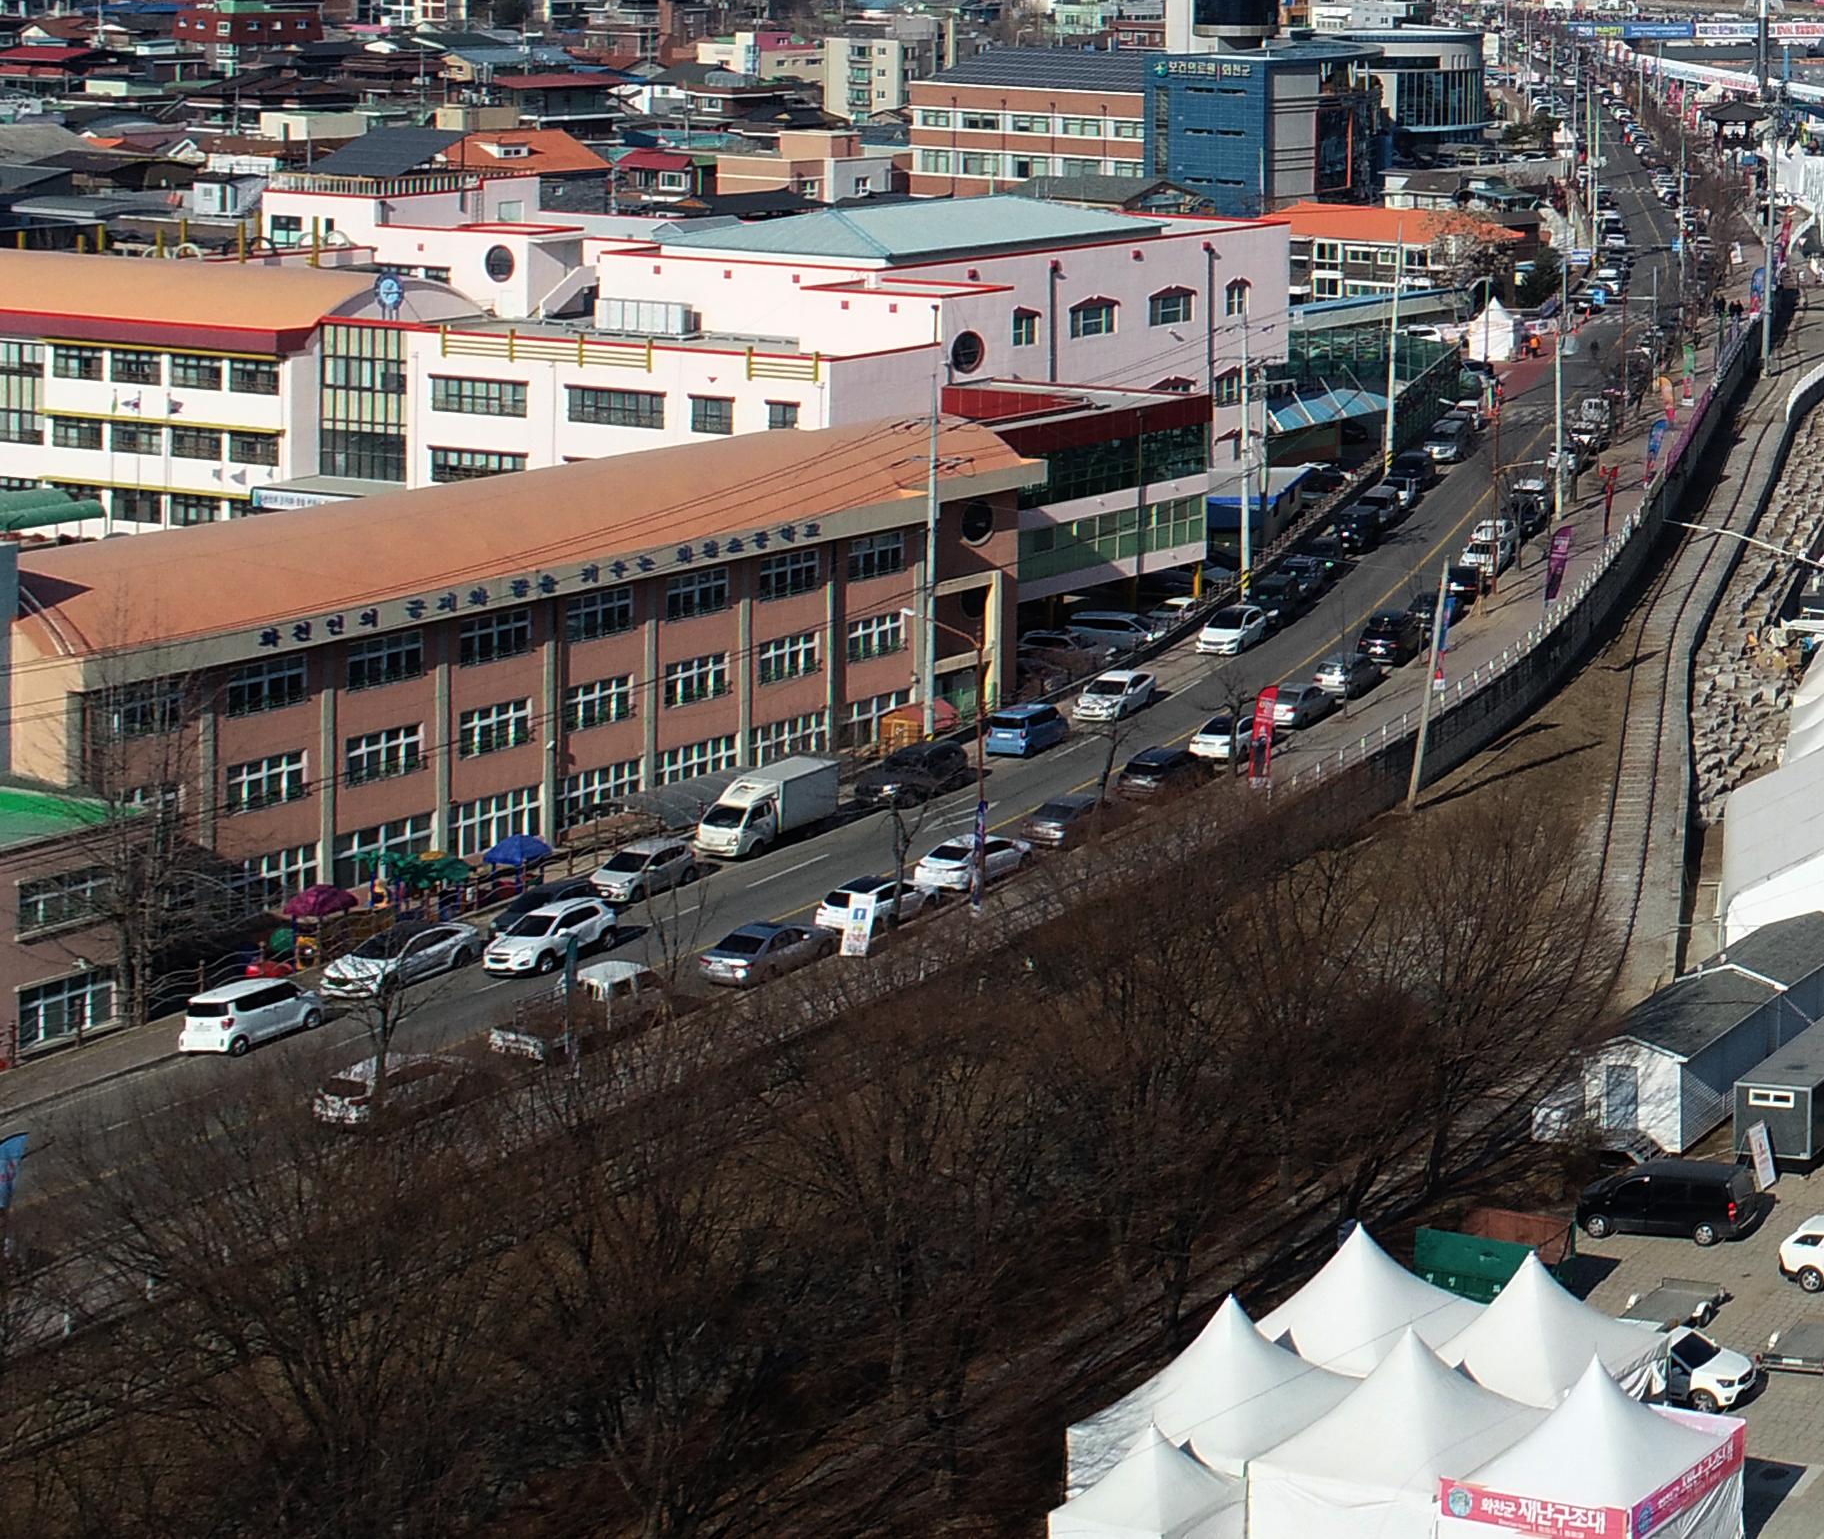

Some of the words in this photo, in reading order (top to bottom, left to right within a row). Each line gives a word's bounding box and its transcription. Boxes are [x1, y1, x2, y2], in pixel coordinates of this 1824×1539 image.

[1168, 61, 1216, 75] 보건의료원
[1222, 63, 1251, 77] 화천군
[676, 523, 822, 564] 화천초등학교
[1479, 1497, 1517, 1520] 화천군
[1517, 1497, 1608, 1536] 재난구조대
